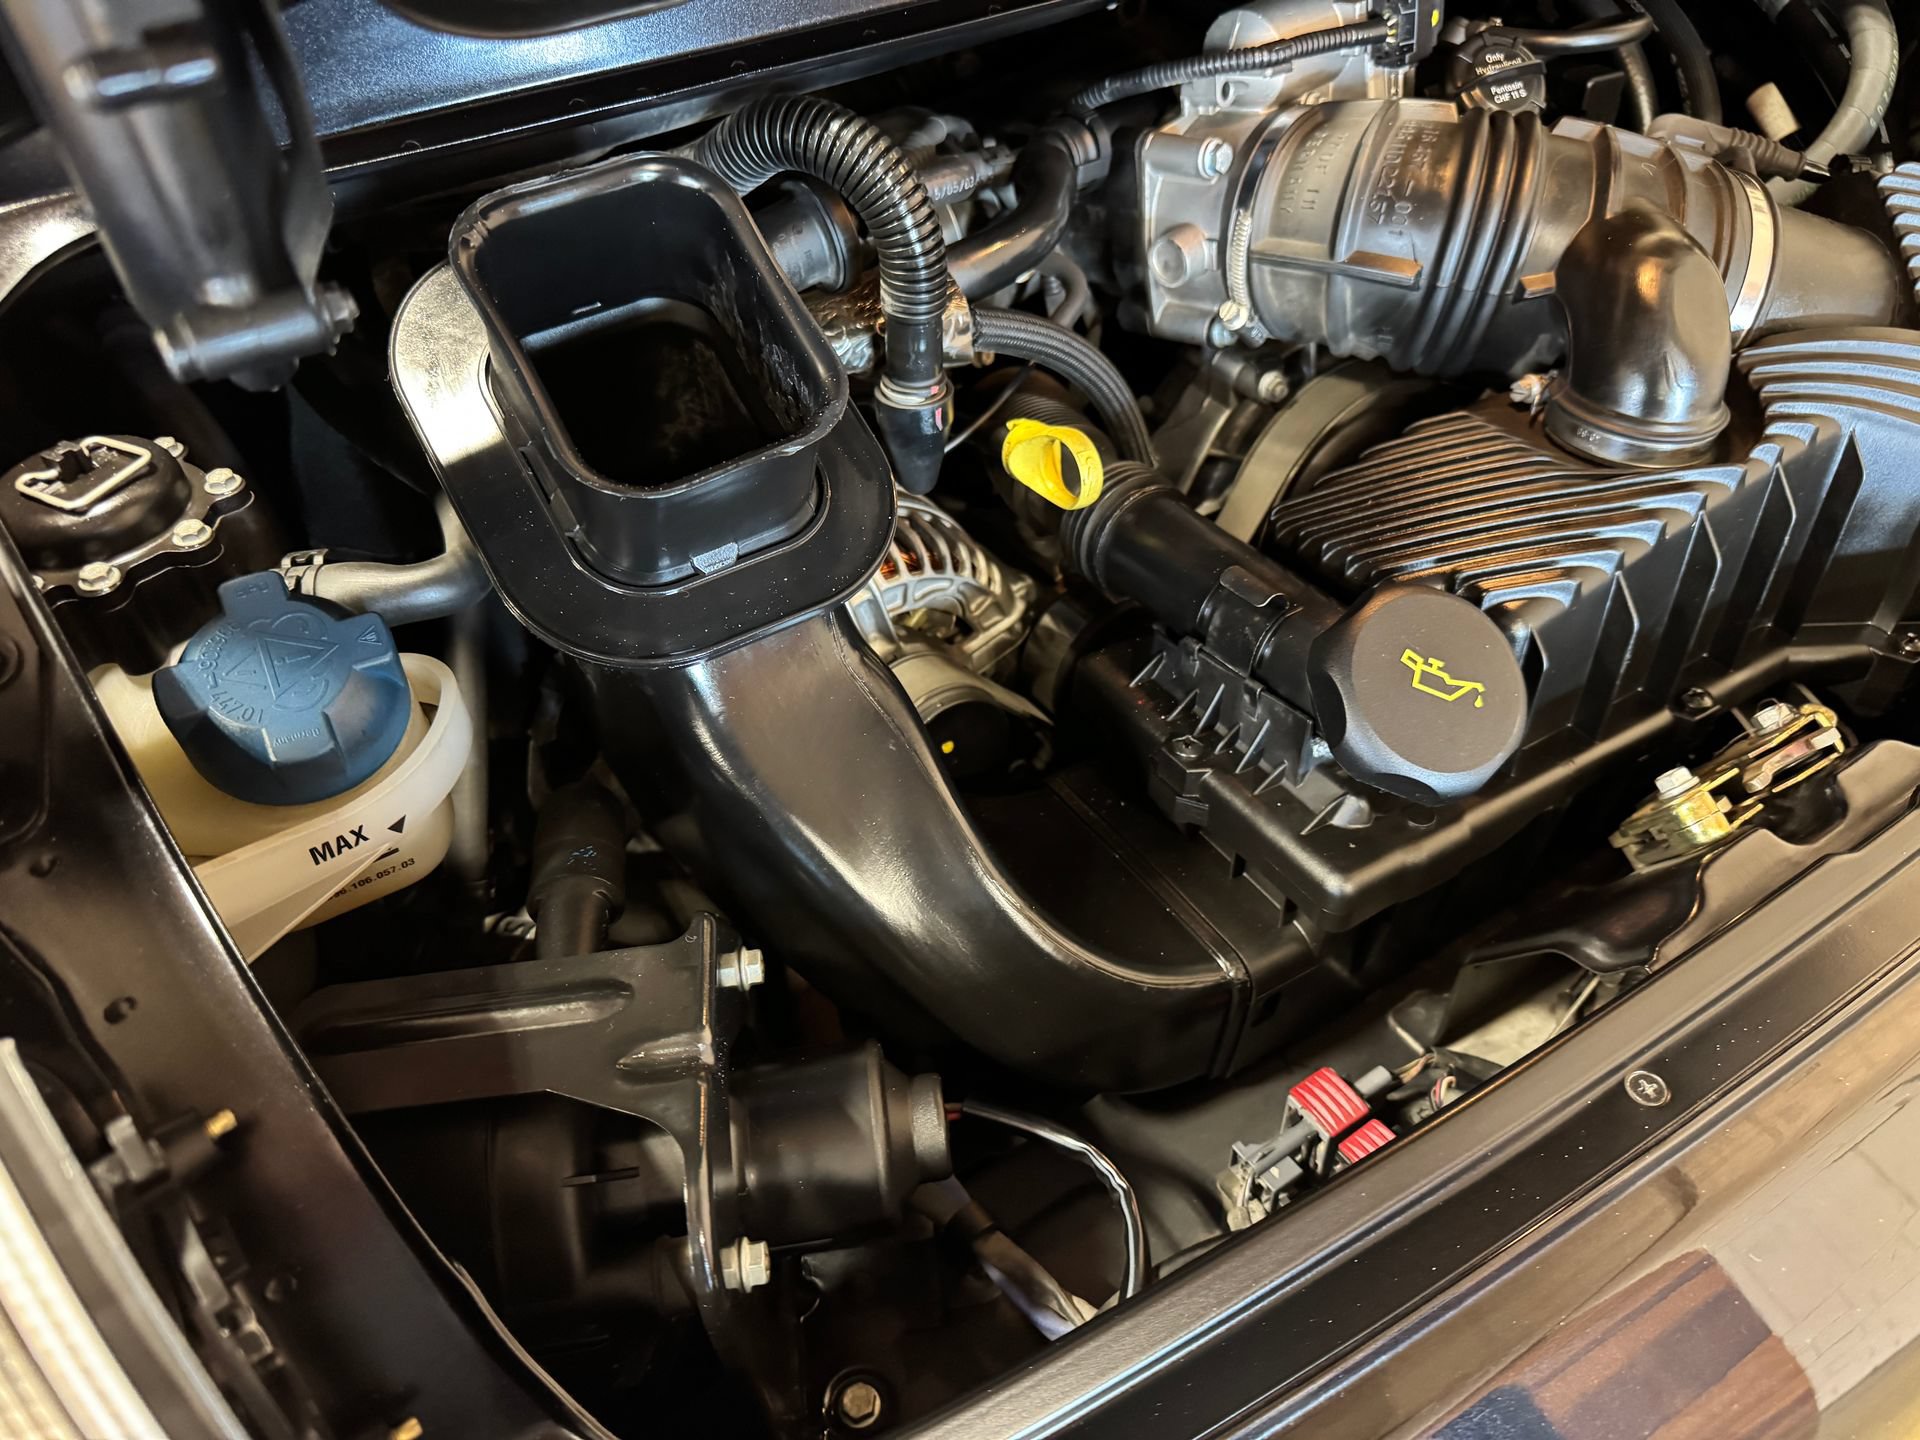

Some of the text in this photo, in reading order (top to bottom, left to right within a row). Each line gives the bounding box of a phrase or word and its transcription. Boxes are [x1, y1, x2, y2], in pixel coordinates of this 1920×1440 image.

[1485, 52, 1505, 63] Only
[1490, 80, 1524, 95] Pentosin
[1494, 89, 1528, 104] CHF 11 S
[308, 824, 370, 866] MAX
